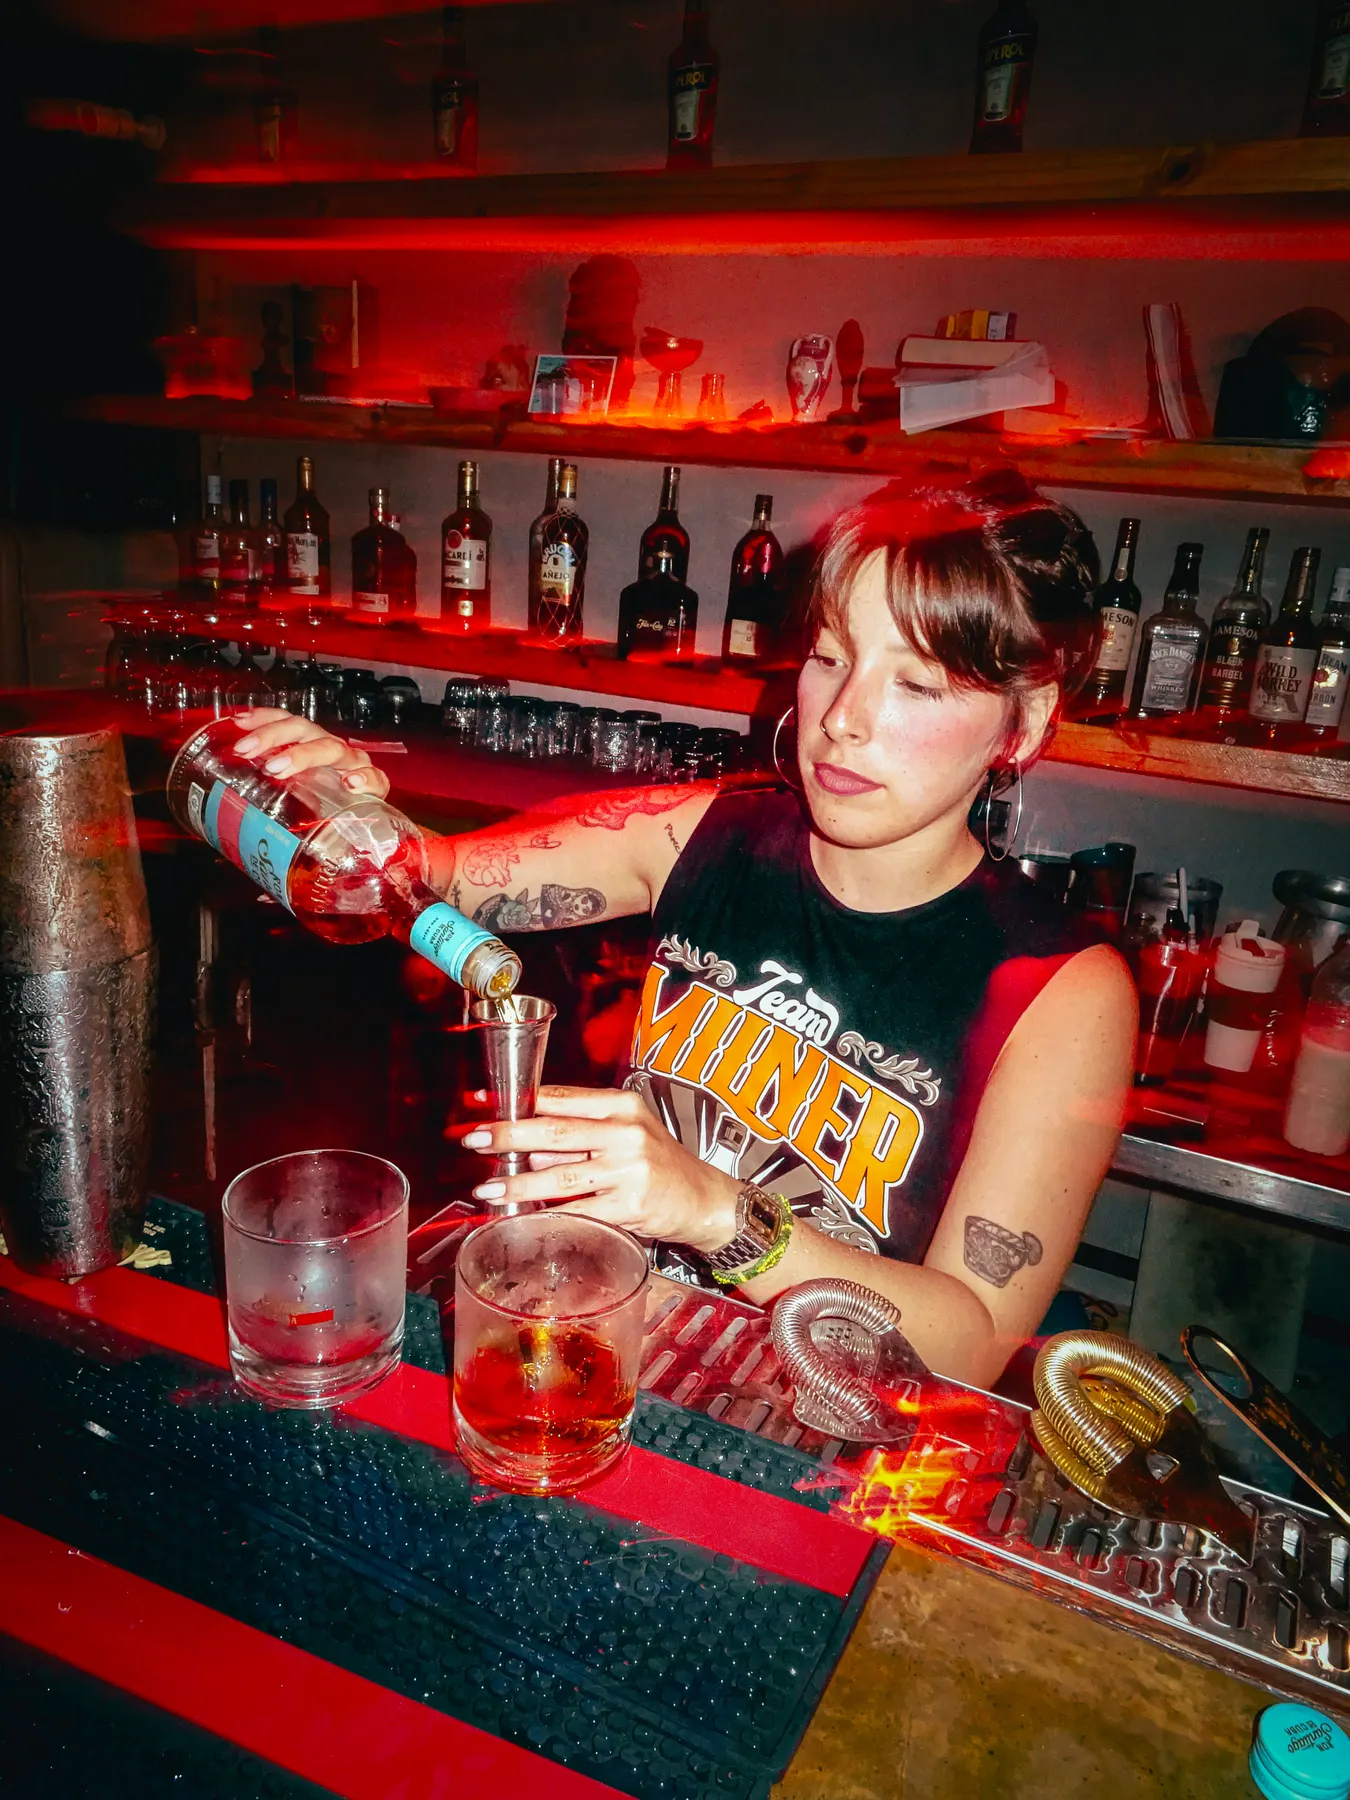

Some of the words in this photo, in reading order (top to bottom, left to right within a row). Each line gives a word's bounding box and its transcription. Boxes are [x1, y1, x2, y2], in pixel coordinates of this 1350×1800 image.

[986, 42, 1025, 62] PEROL
[675, 71, 707, 87] PEROL
[447, 550, 473, 561] CARDÍ
[542, 569, 570, 580] AÑEJO
[1103, 612, 1135, 627] MESON
[1213, 625, 1259, 640] JAMESON
[1151, 647, 1169, 661] JACK
[1266, 661, 1298, 679] WILD
[732, 959, 840, 1047] Team
[631, 962, 924, 1238] MILNER
[1284, 1721, 1308, 1736] CUBA
[1287, 1722, 1332, 1753] Santiago
[1316, 1741, 1335, 1752] RON
